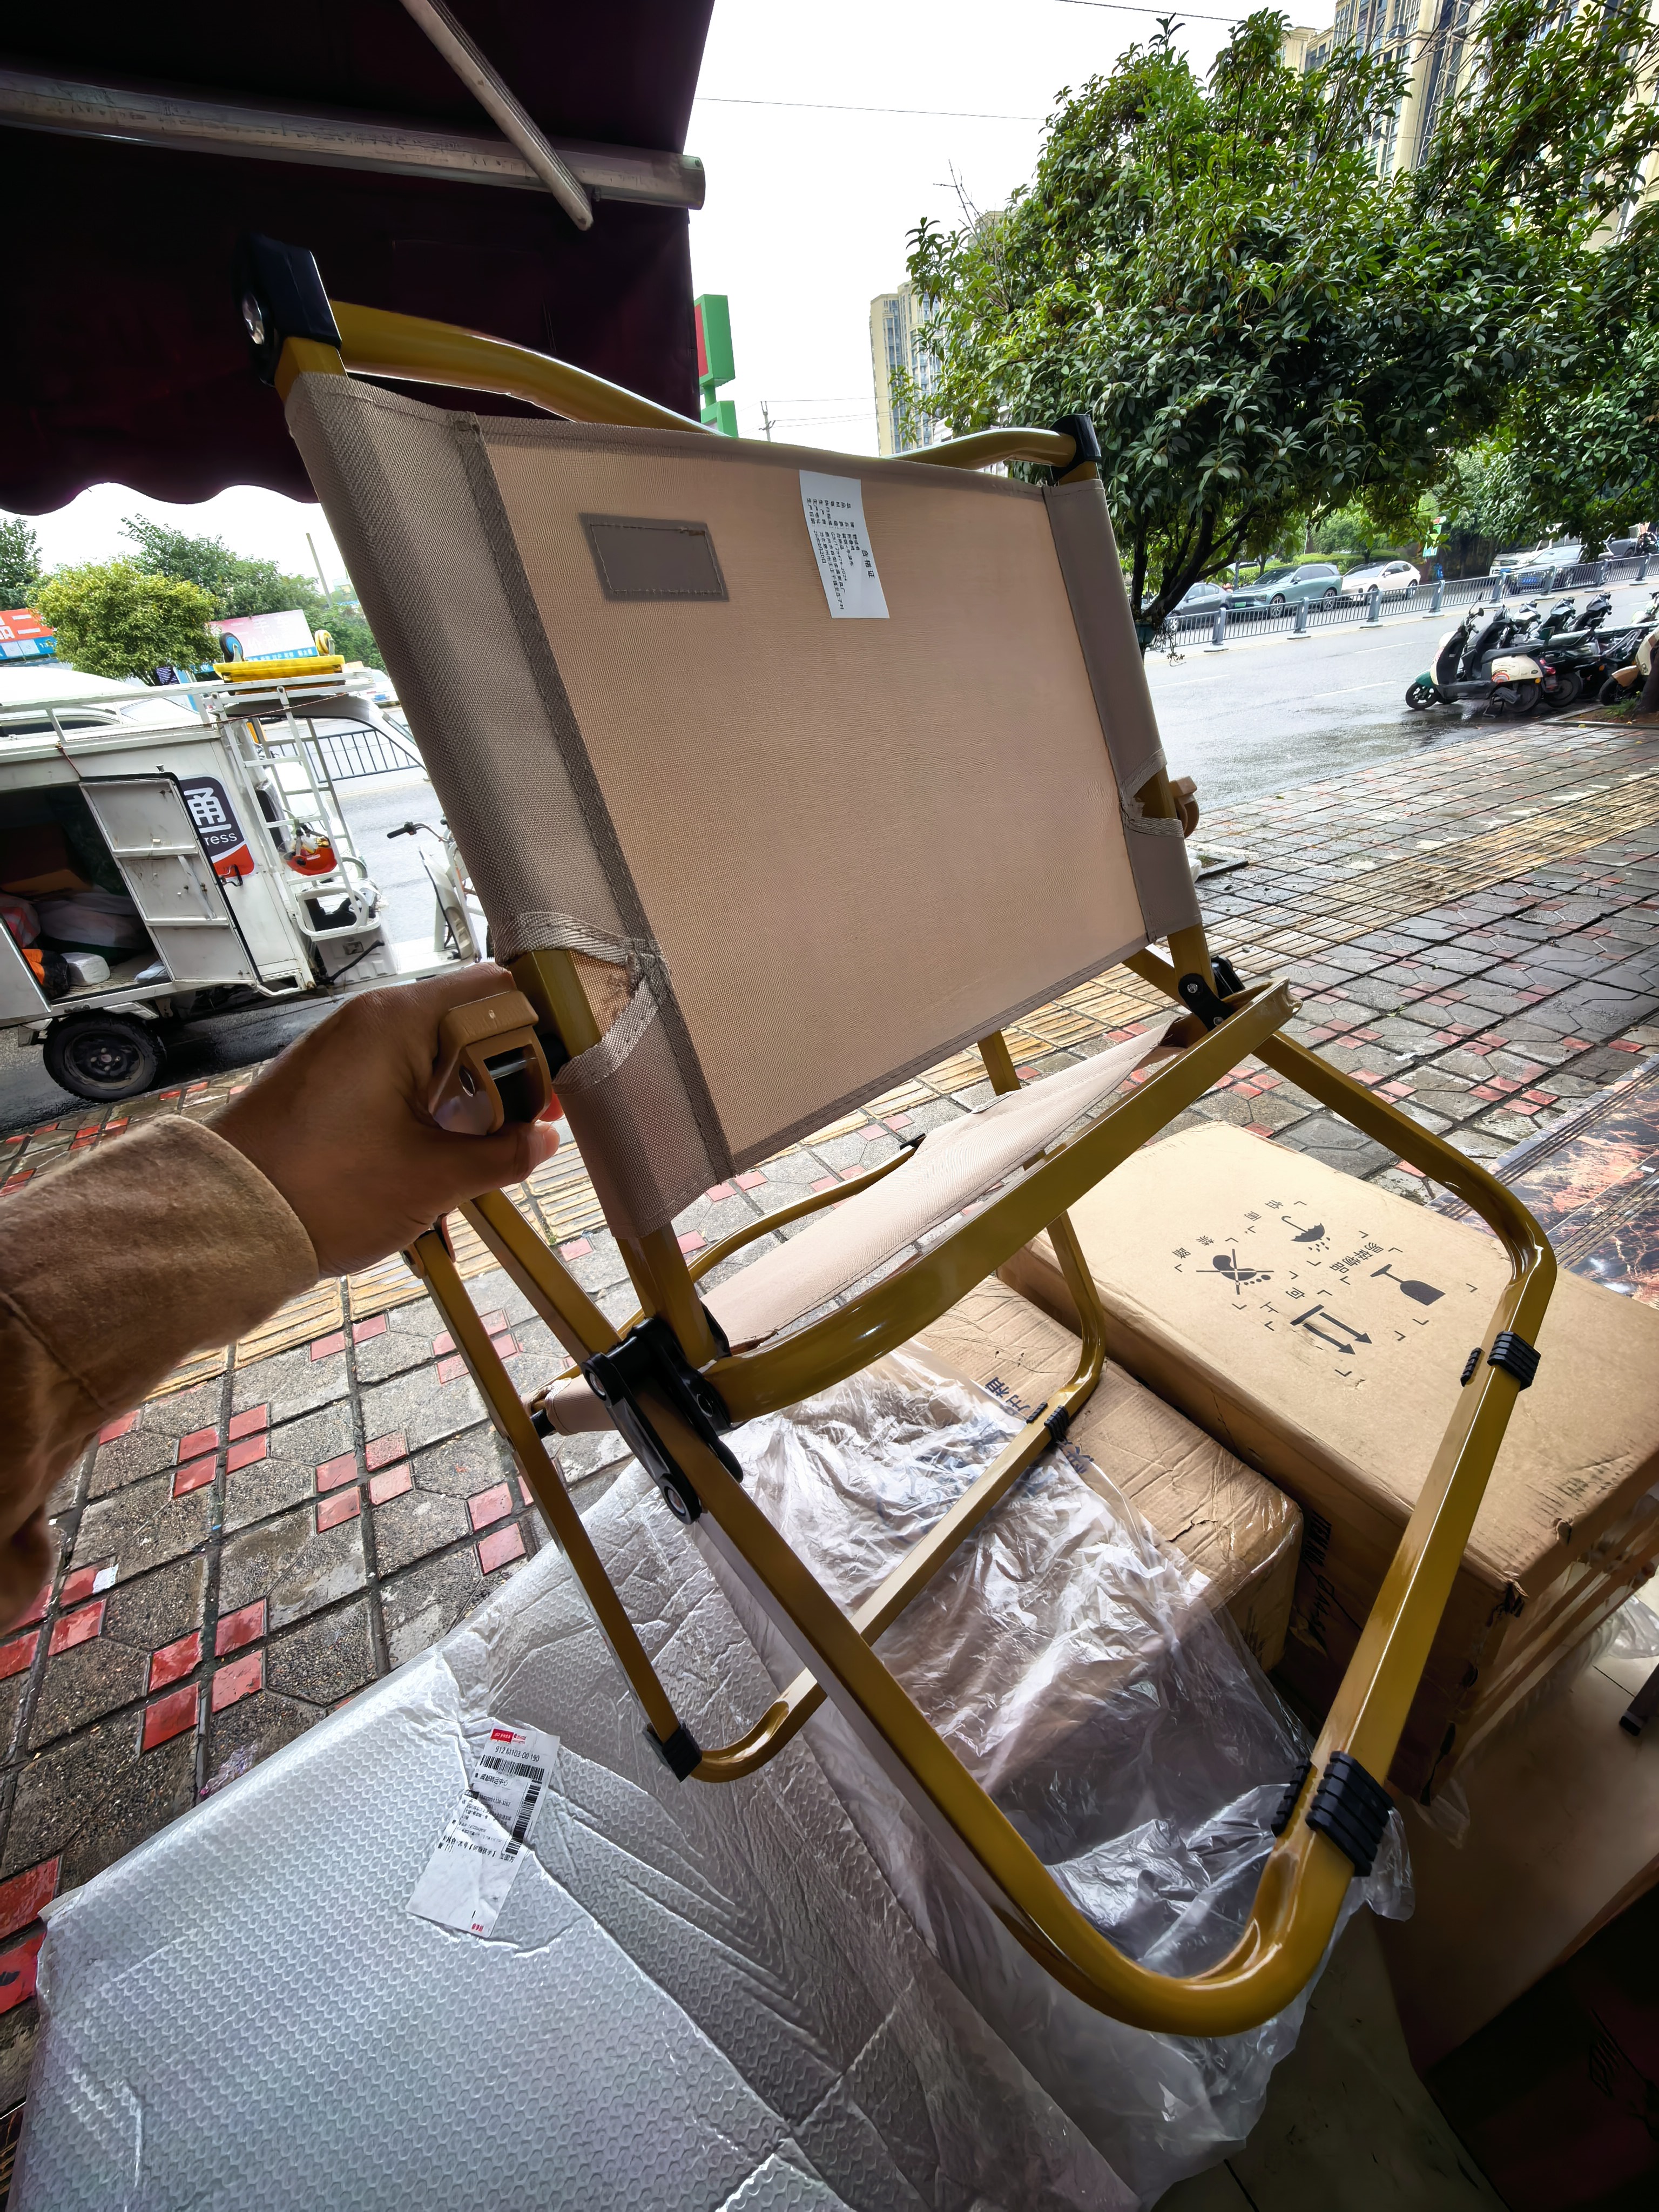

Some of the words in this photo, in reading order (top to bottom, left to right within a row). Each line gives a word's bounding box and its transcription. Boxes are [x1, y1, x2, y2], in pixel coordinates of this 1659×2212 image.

[204, 833, 237, 846] ress
[1329, 1242, 1384, 1273] 易碎物品
